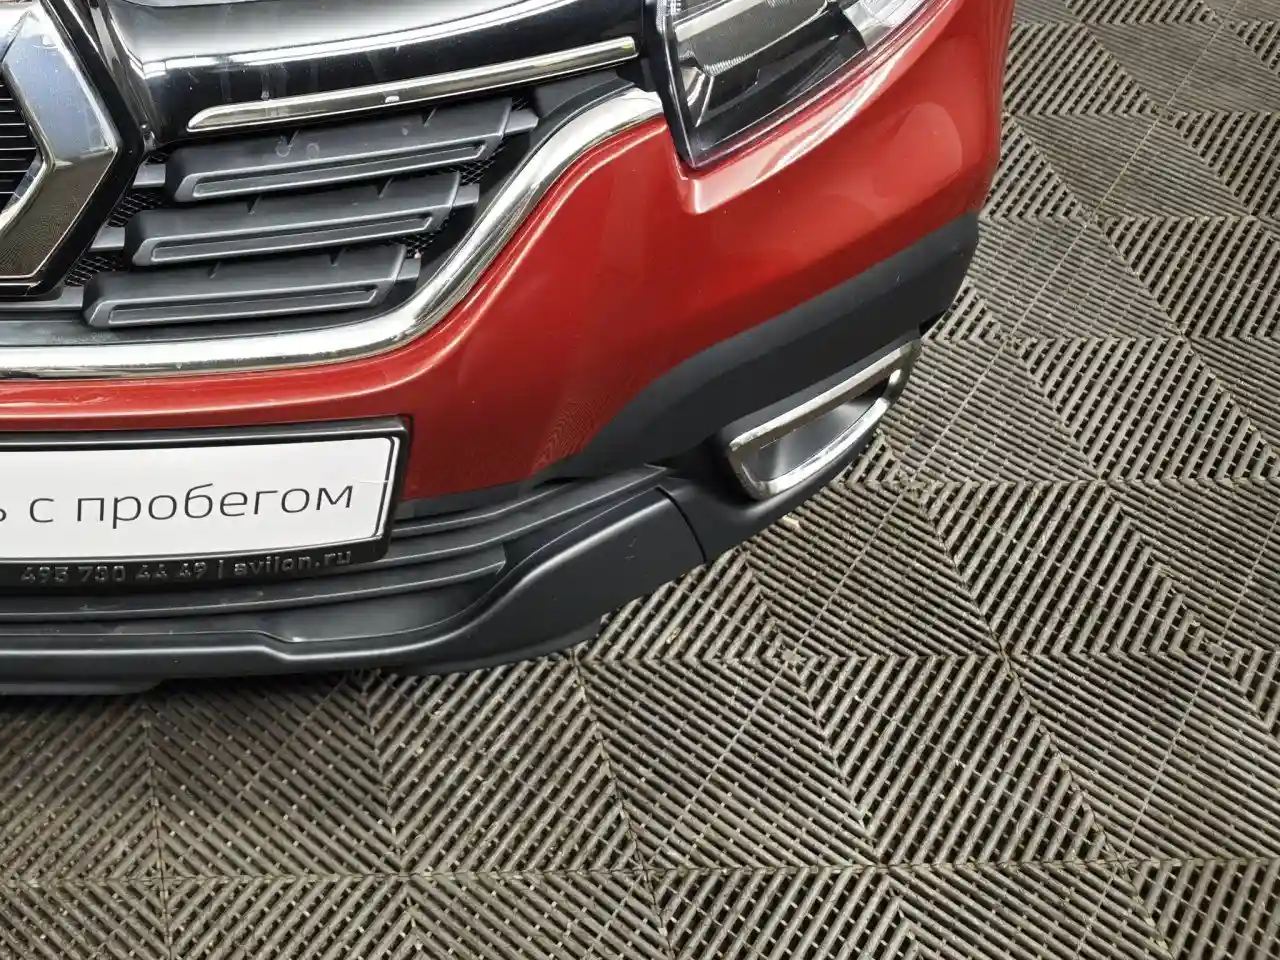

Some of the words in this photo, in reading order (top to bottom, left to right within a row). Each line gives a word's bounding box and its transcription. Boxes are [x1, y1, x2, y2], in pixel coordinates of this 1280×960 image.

[29, 497, 54, 523] с
[76, 483, 353, 530] пробегом
[233, 550, 352, 576] avilon.ru
